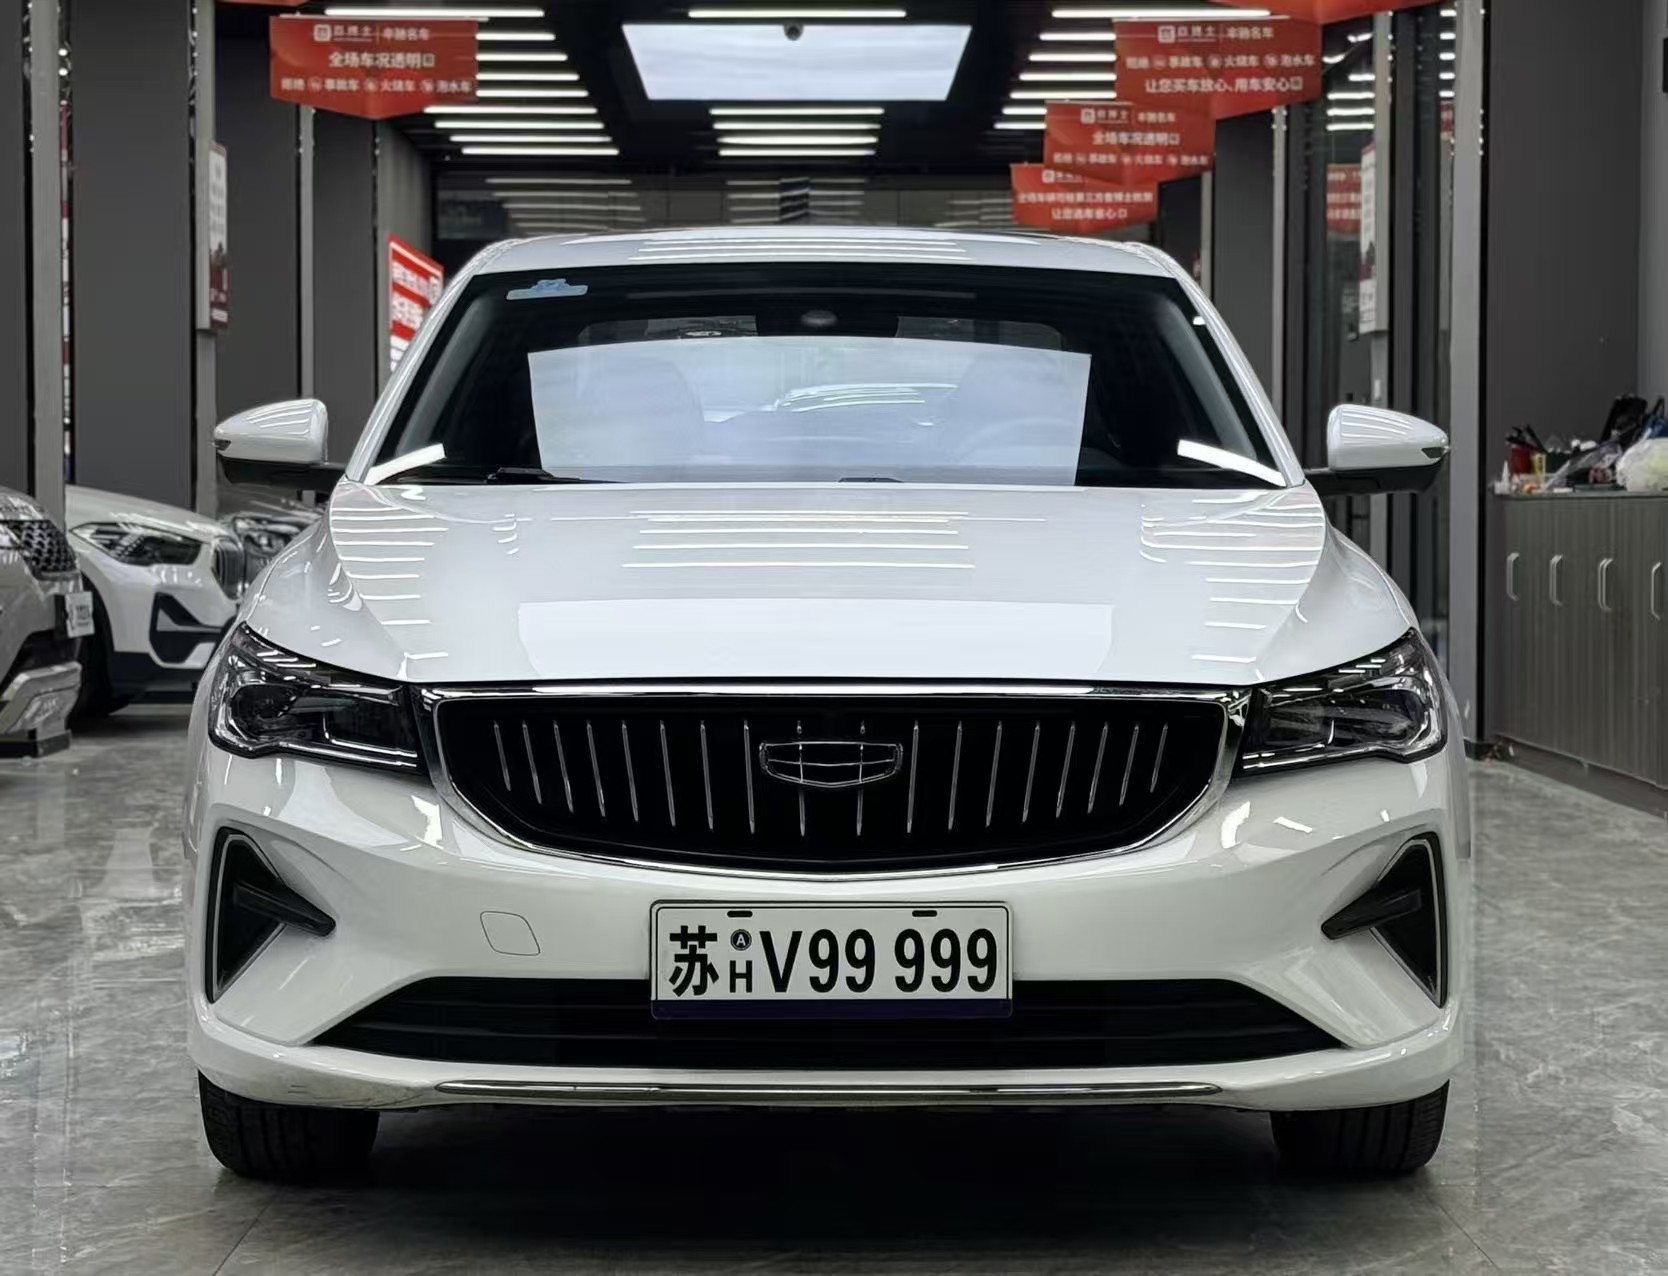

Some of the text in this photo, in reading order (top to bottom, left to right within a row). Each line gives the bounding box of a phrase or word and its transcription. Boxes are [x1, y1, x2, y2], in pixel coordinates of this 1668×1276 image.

[668, 925, 998, 998] 苏 H V99 999
